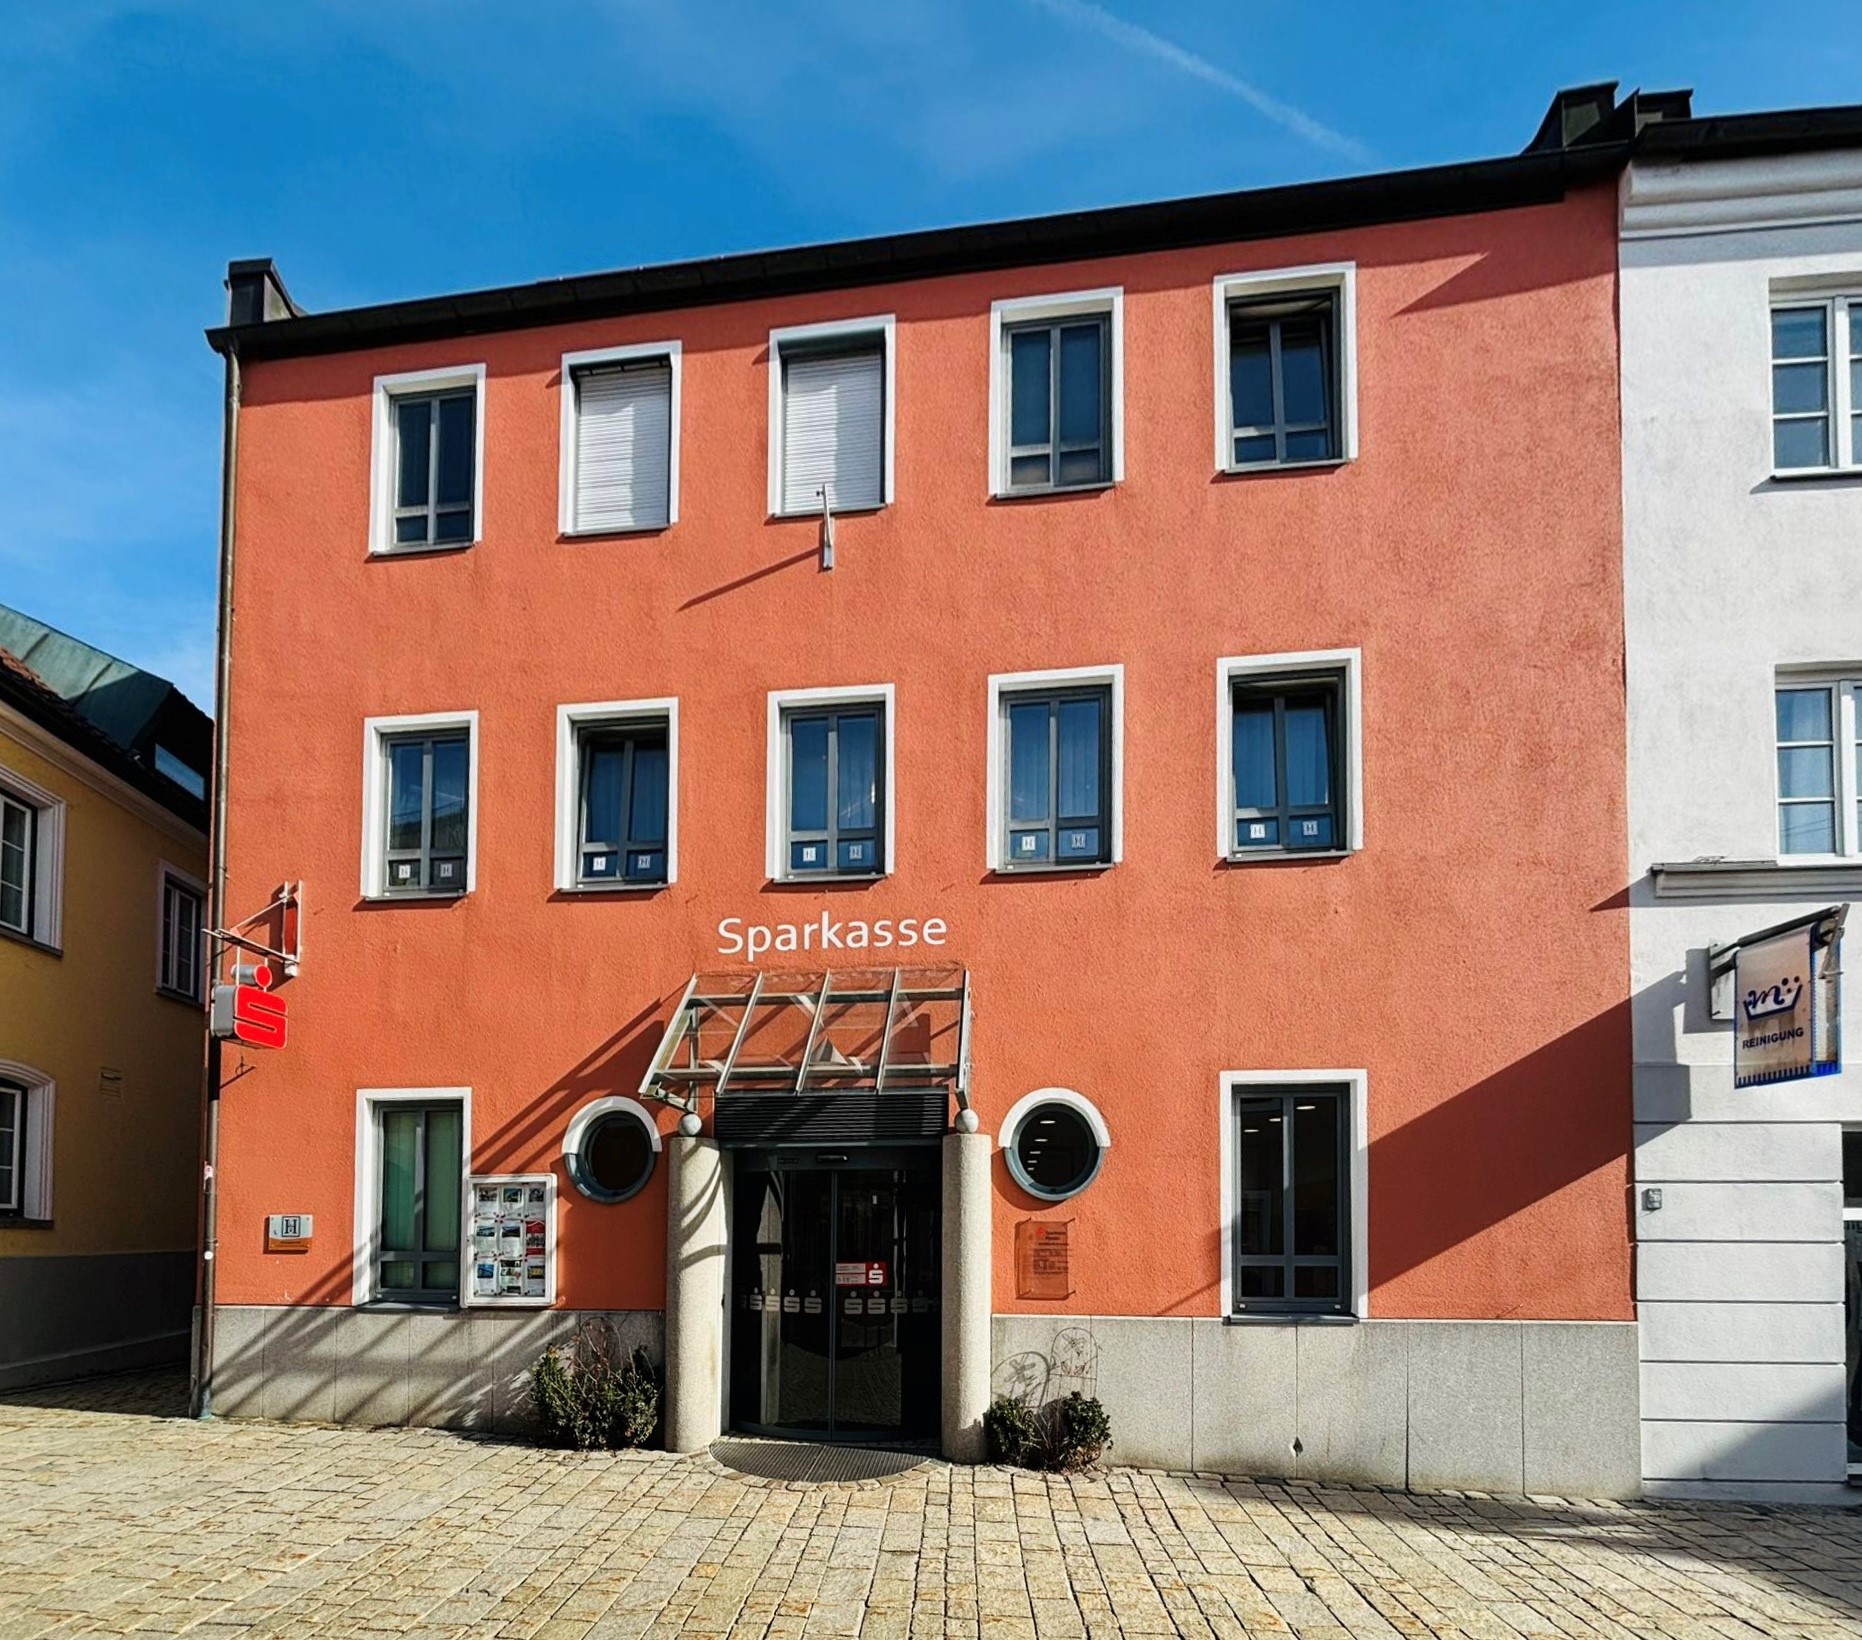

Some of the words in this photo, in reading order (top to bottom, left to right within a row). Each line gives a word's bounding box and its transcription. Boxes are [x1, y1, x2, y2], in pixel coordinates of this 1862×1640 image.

[717, 911, 947, 962] Sparkasse
[1742, 1027, 1804, 1049] REINIGUNG
[284, 1219, 297, 1234] H
